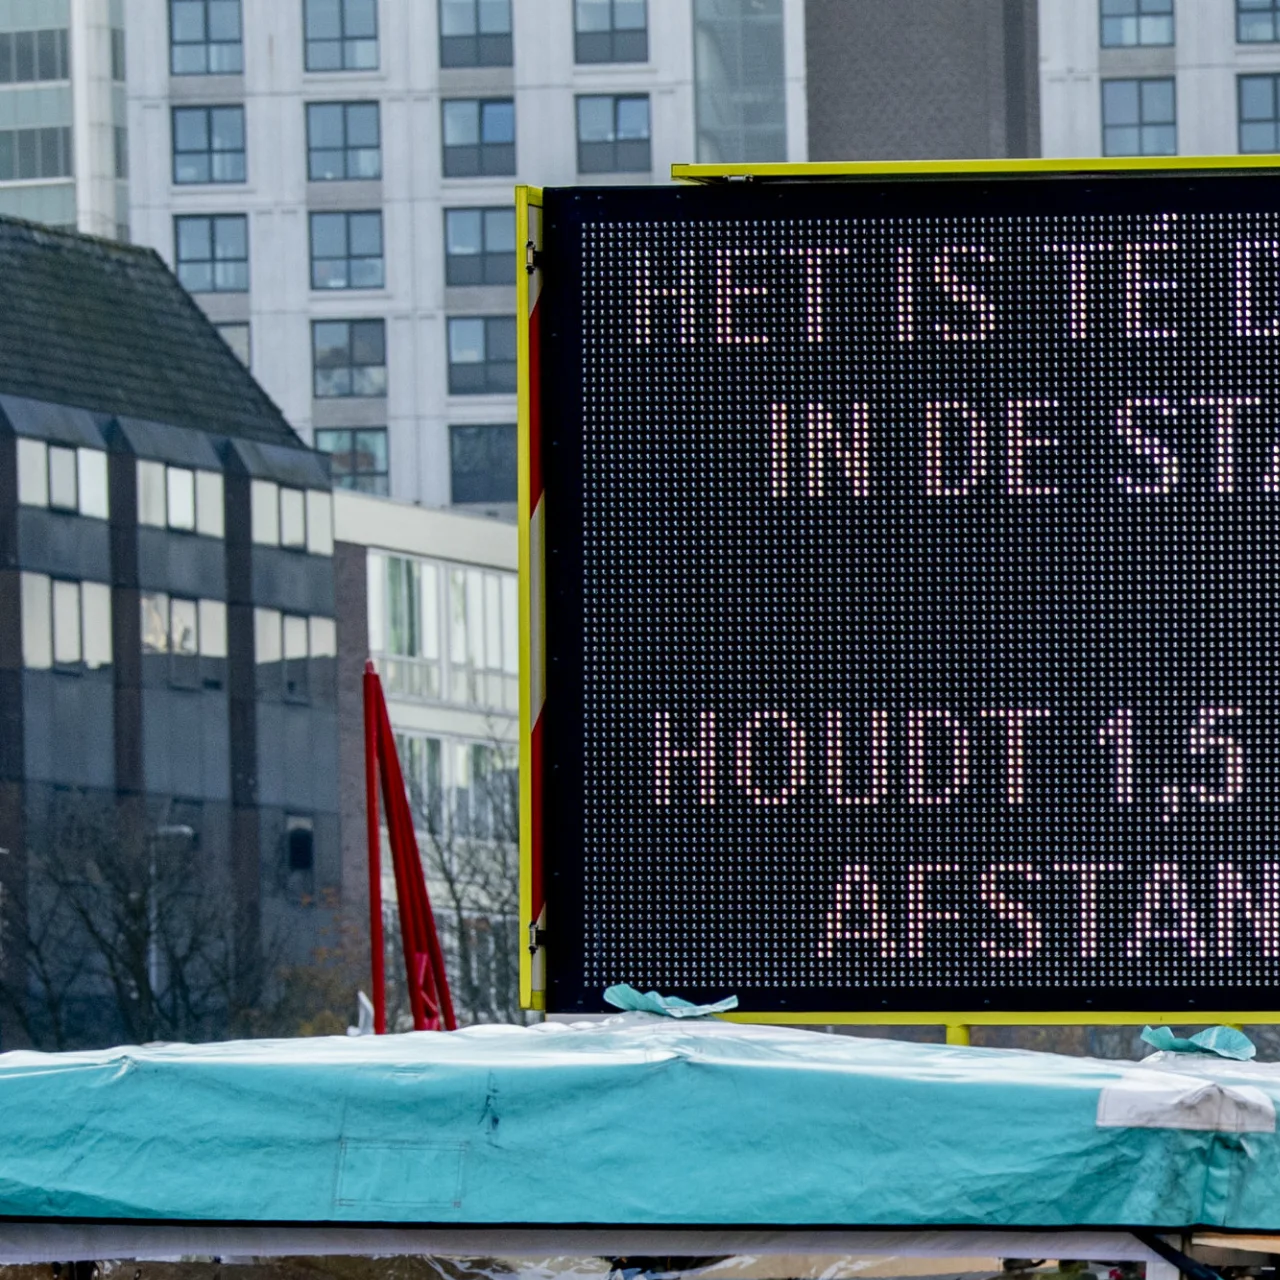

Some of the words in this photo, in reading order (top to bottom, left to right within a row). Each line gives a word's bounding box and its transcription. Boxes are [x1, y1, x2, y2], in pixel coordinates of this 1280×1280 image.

[632, 246, 848, 346] HET
[896, 247, 995, 342] IS
[1043, 212, 1180, 340] TÉ
[769, 401, 871, 498] IN
[924, 399, 1060, 496] DE
[652, 709, 1050, 807] HOUDT
[1096, 705, 1247, 823] 1,5
